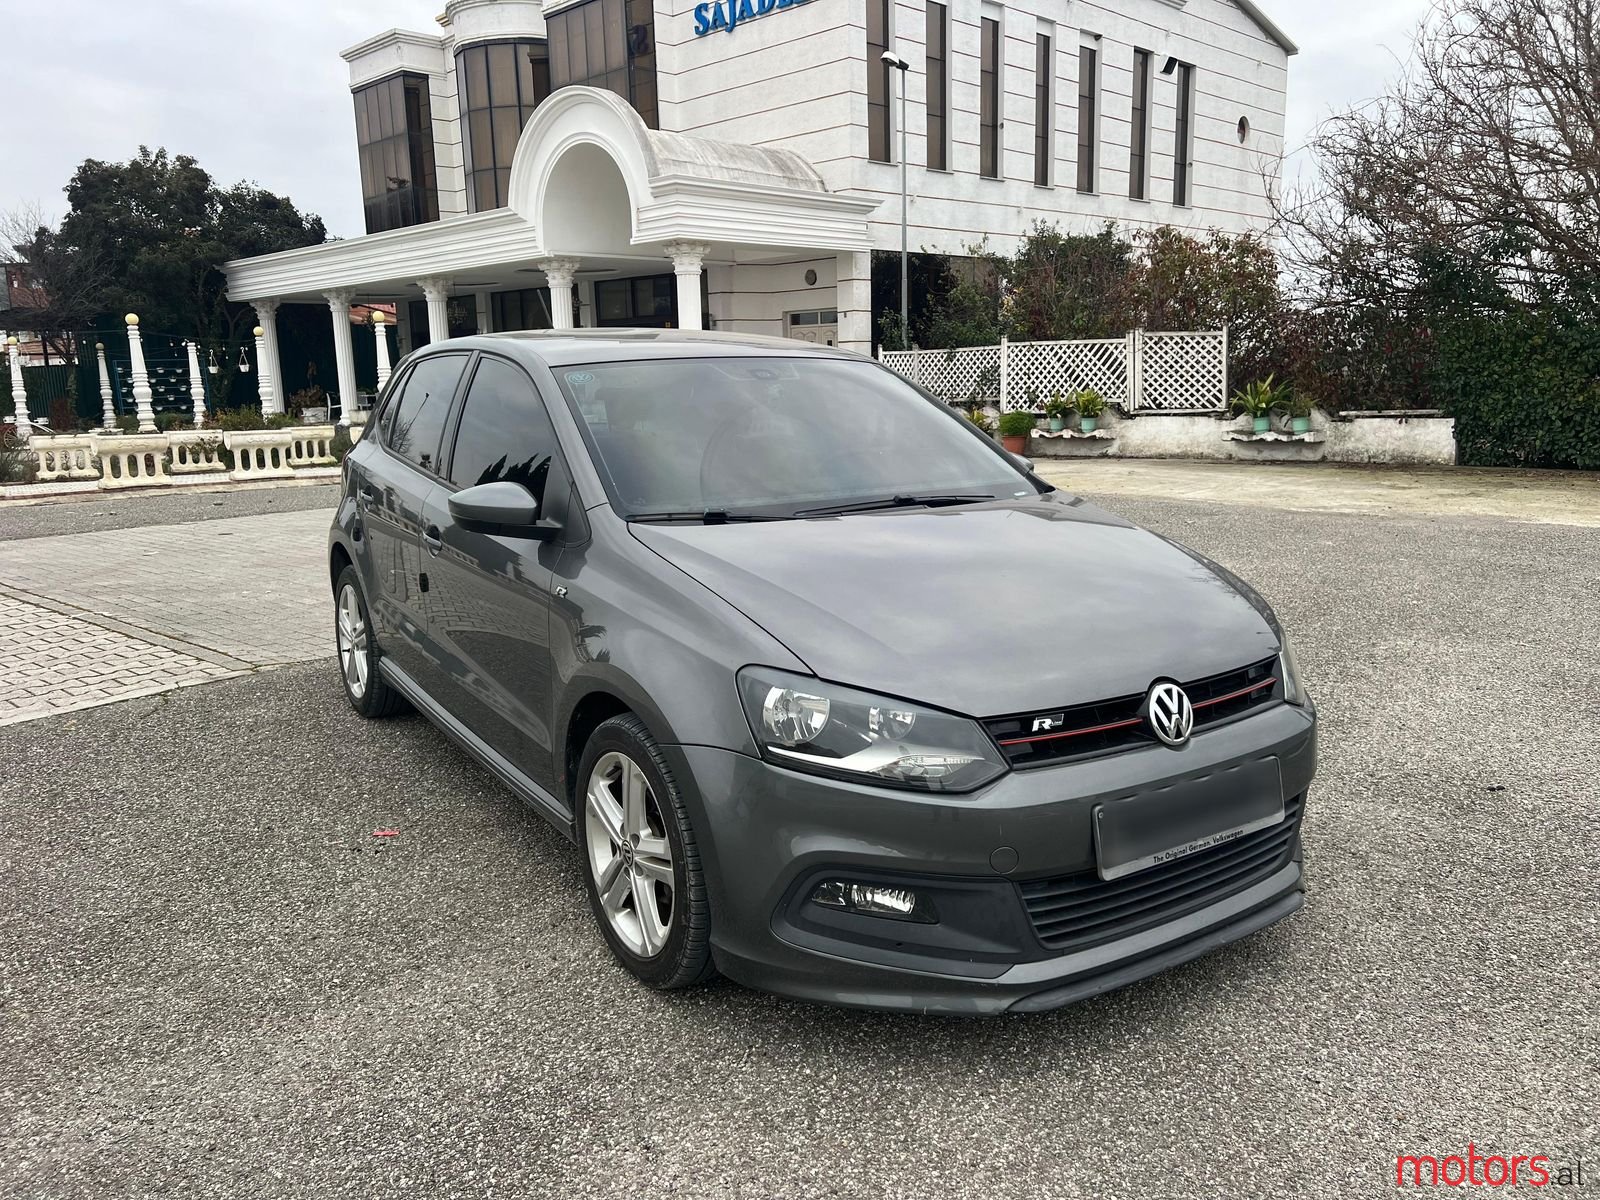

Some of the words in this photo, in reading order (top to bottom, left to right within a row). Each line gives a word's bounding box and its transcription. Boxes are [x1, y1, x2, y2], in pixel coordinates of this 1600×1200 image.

[1153, 856, 1164, 864] The
[1165, 846, 1188, 859] Original
[1212, 829, 1244, 844] Volkswagen
